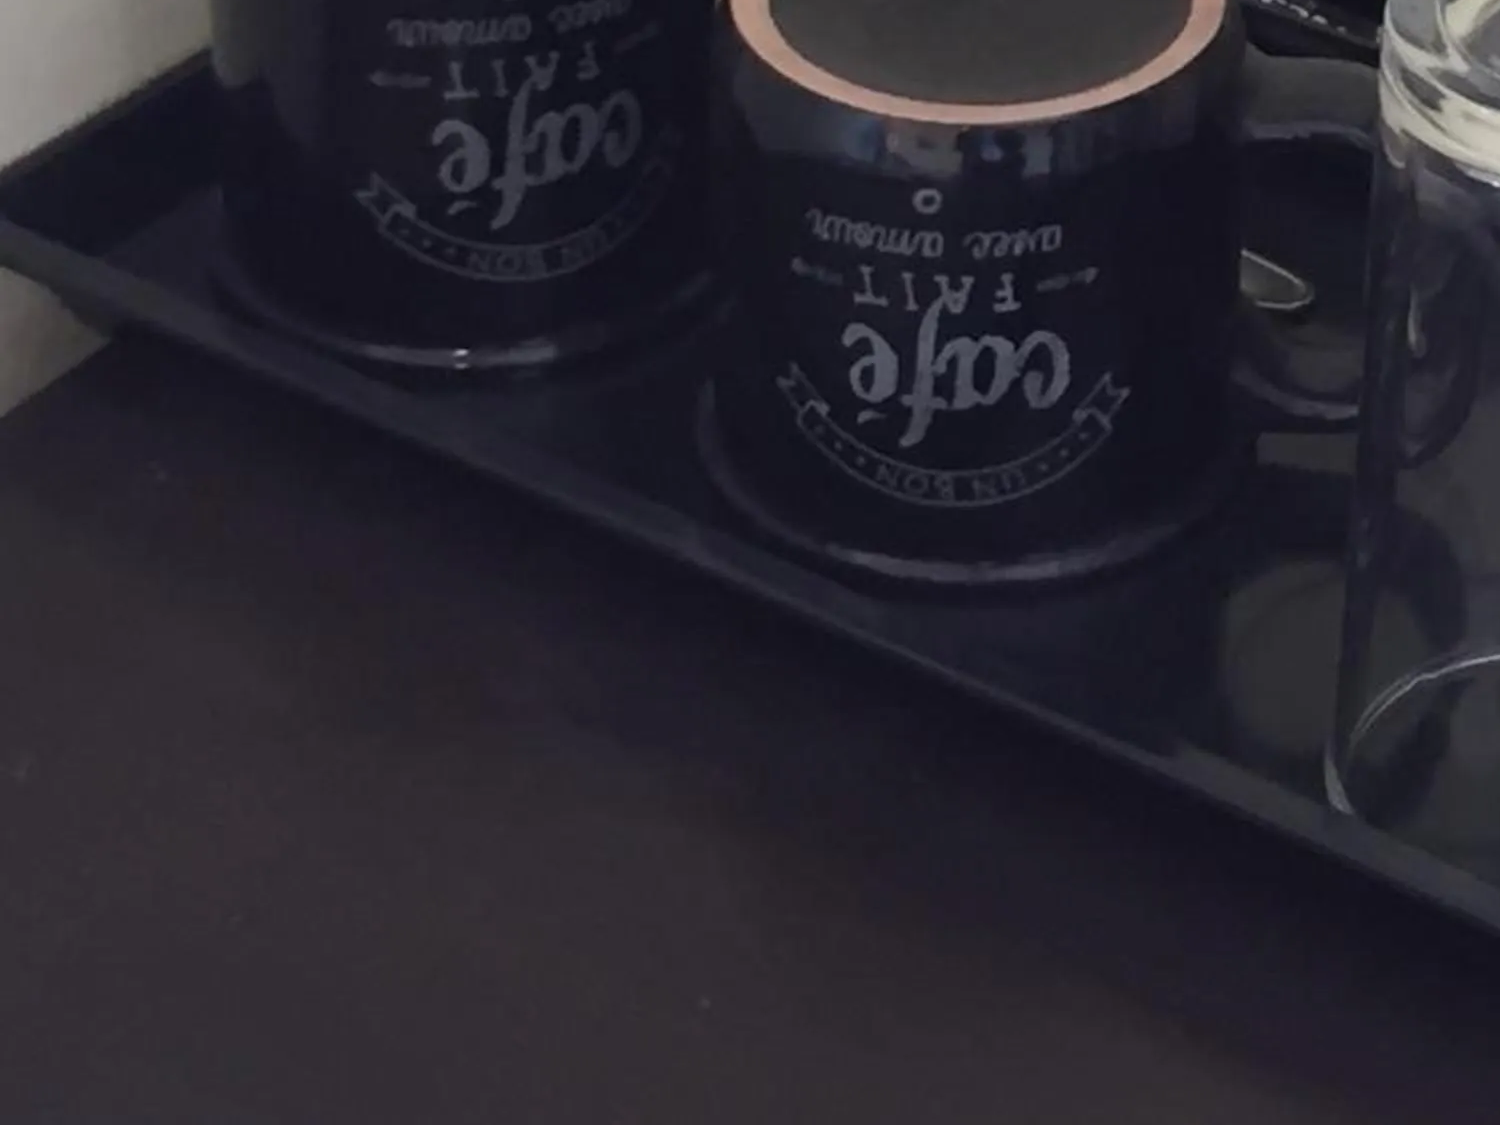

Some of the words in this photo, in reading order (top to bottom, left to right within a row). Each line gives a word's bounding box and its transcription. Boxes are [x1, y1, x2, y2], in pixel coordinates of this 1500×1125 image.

[385, 13, 532, 47] amour
[443, 40, 601, 100] FAIT
[432, 76, 642, 230] café
[805, 208, 945, 258] amour
[963, 224, 1063, 260] avec
[853, 265, 1022, 314] FAIT
[841, 299, 1071, 448] café
[875, 463, 956, 500] BON
[972, 467, 1027, 500] UN
